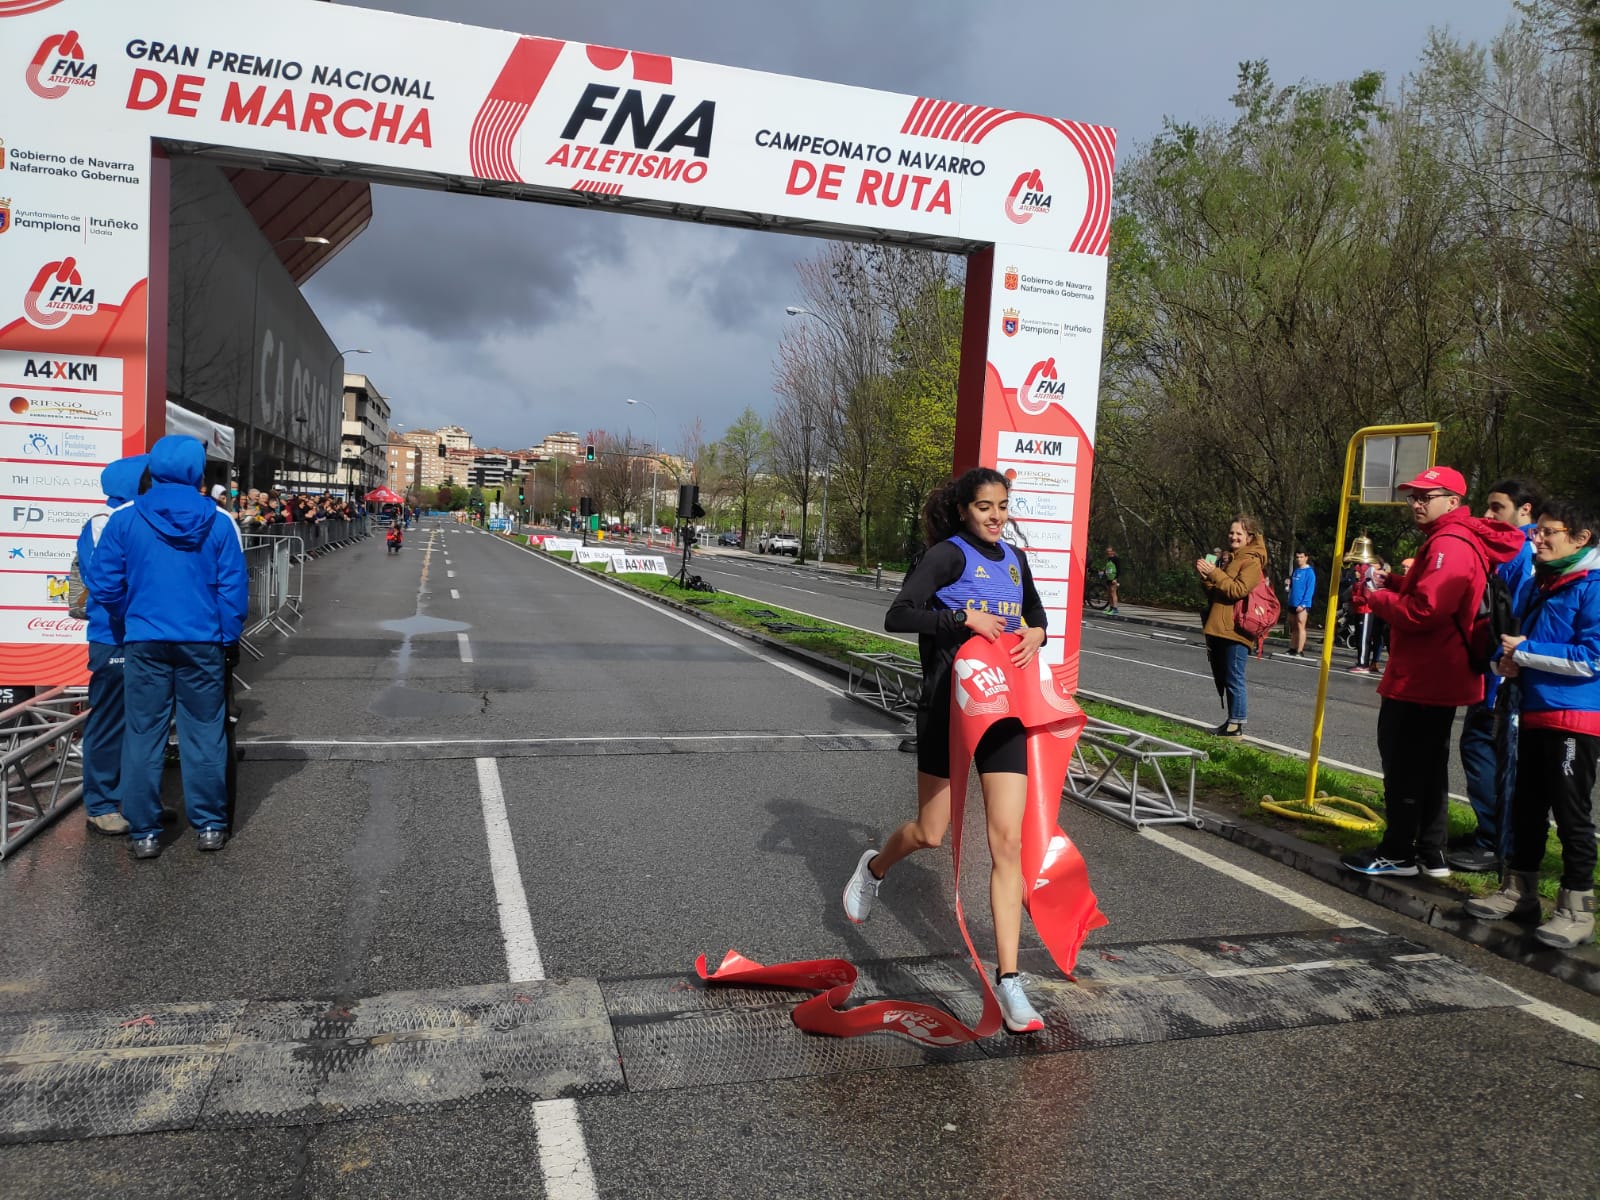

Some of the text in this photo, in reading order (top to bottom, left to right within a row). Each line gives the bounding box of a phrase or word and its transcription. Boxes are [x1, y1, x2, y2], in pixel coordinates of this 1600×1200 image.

[51, 59, 98, 80] FNA
[125, 39, 435, 100] GRAN PREMIO NACIONAL
[48, 75, 96, 87] ATLETISMO
[125, 68, 433, 148] DE MARCHA
[559, 83, 716, 158] FNA
[10, 148, 135, 171] Gobierno de Navarra
[754, 129, 986, 177] CAMPEONATO NAVARRO
[545, 143, 708, 183] ATLETISMO
[10, 161, 140, 184] Nafarroako Gobernua
[785, 159, 952, 215] DE RUTA
[1021, 192, 1052, 208] FNA
[15, 209, 81, 222] Ayuntamiento de
[1018, 204, 1050, 214] ATLETISMO
[14, 217, 81, 233] Pamplona
[90, 216, 139, 231] Iruñeko
[90, 228, 113, 236] Udala
[1021, 274, 1093, 291] Gobierno de Navarra
[49, 286, 96, 304] FNA
[1020, 284, 1095, 300] Nafarroako Gobernua
[45, 301, 94, 312] ATLETISMO
[1020, 325, 1059, 335] Pamplona
[23, 359, 98, 382] A4XKM
[261, 328, 286, 435] CA
[1036, 380, 1066, 395] FNA
[30, 399, 82, 409] RIESGO
[1015, 438, 1062, 457] A4XKM
[32, 474, 70, 487] IRUÑA
[74, 479, 100, 489] PAR
[28, 548, 71, 559] Fundación
[625, 558, 657, 571] A4XKM
[972, 666, 1007, 692] FNA
